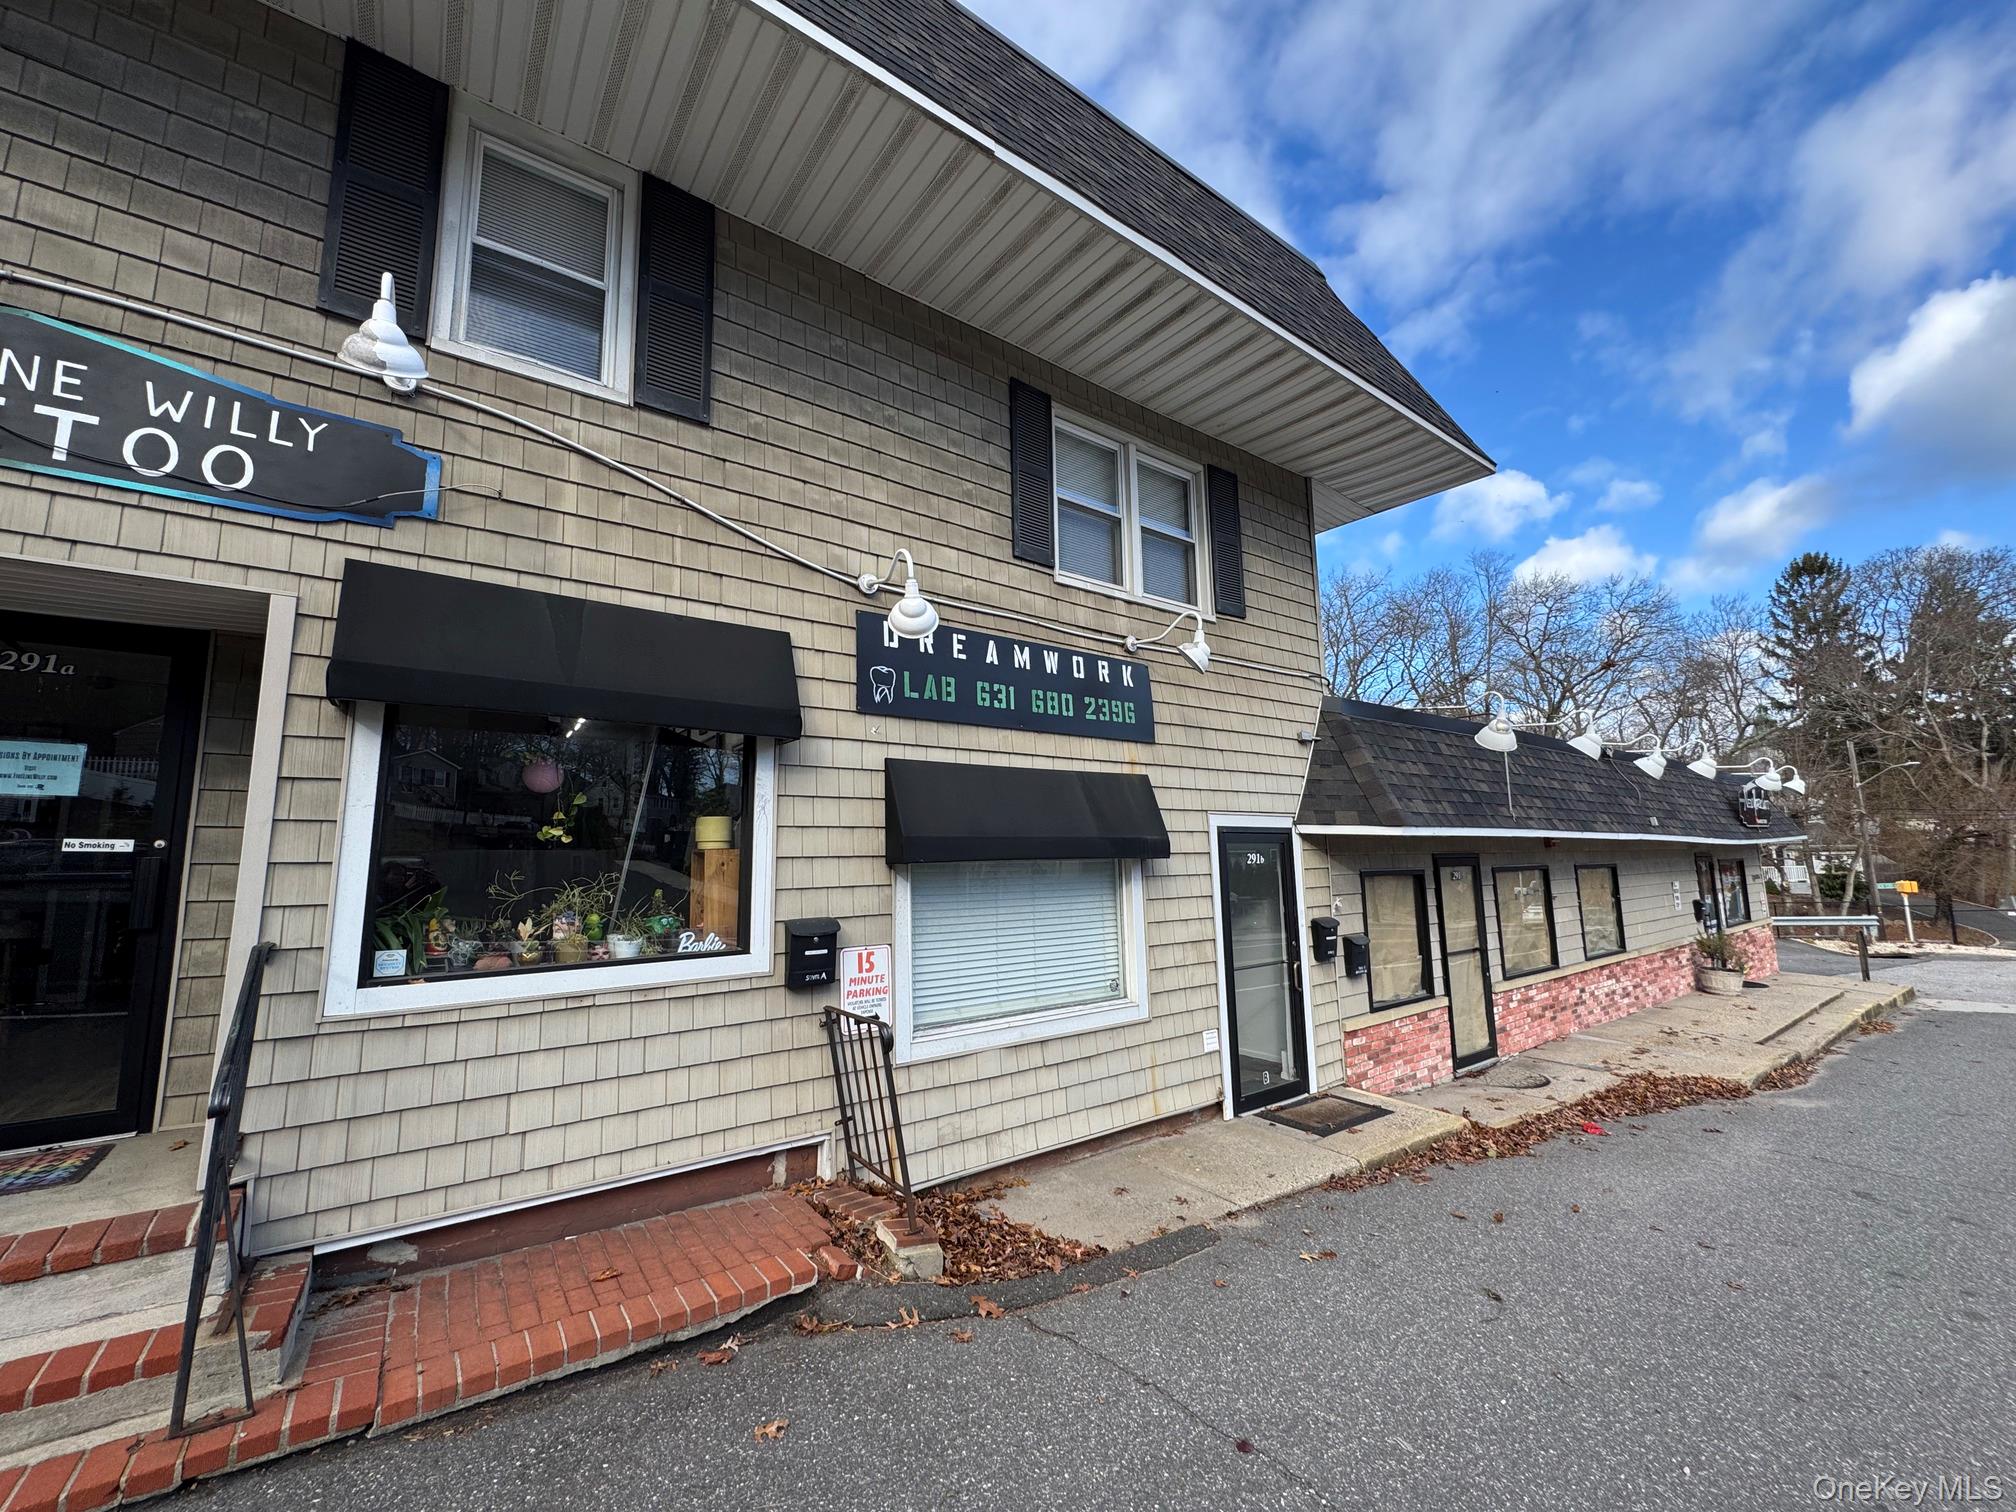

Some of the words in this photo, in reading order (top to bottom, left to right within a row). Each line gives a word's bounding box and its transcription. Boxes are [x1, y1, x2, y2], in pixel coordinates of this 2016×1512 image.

[146, 381, 328, 452] WILLY
[0, 397, 254, 491] TOO
[0, 650, 76, 675] 291a
[883, 620, 1134, 687] DREAMWORK
[904, 671, 956, 702] LAB
[976, 681, 1015, 710] 631
[1031, 689, 1074, 717] 680
[1084, 696, 1136, 724] 2396
[64, 841, 76, 849] No
[78, 841, 116, 850] Smoking
[1246, 853, 1265, 864] 291b
[677, 931, 727, 953] Barbie
[857, 951, 875, 974] 15
[848, 974, 886, 987] MINUTE
[846, 985, 889, 1000] PARKING
